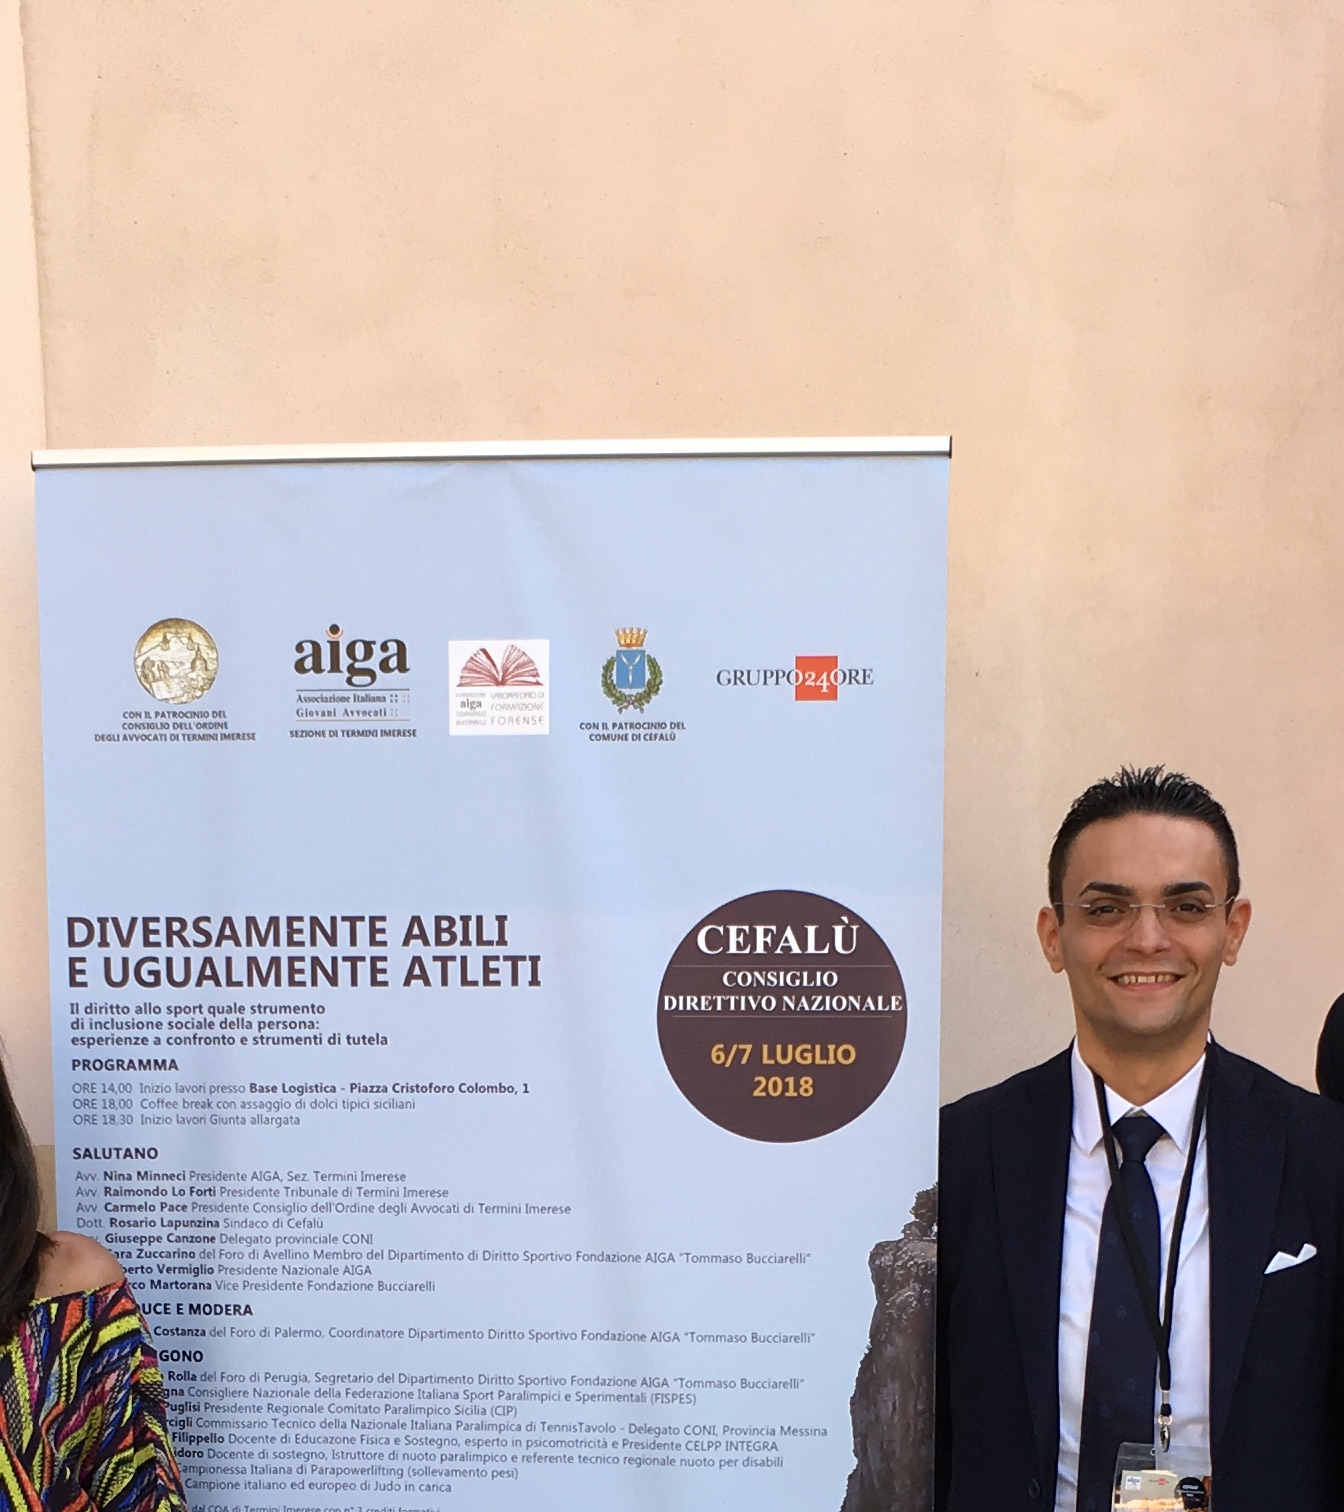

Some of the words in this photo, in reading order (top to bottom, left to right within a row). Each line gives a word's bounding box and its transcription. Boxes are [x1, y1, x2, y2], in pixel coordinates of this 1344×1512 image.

[294, 624, 411, 688] aiga
[459, 698, 482, 711] aiga
[122, 710, 142, 719] CON
[143, 710, 152, 719] IL
[154, 710, 209, 719] PATROCINIO
[211, 710, 227, 719] DEL
[490, 715, 545, 726] FORENSE
[121, 721, 170, 730] CONSIGLIO
[172, 721, 228, 730] DELL'ORDINE
[289, 729, 326, 738] SEZIONE
[328, 729, 338, 738] DI
[340, 728, 378, 737] TERMINI
[379, 728, 417, 737] IMERESE
[579, 722, 599, 730] CON
[601, 722, 609, 730] IL
[611, 721, 667, 730] PATROCINIO
[669, 721, 686, 730] DEL
[94, 733, 120, 742] DEGLI
[121, 733, 167, 742] AVVOCATI
[169, 733, 179, 741] DI
[181, 732, 218, 741] TERMINI
[219, 732, 255, 741] IMERESE
[588, 732, 629, 741] COMUNE
[631, 732, 641, 741] DI
[642, 731, 676, 741] CEFALÙ
[66, 915, 387, 948] DIVERSAMENTE
[401, 914, 508, 947] ABILI
[697, 916, 859, 954] CEFALÙ
[68, 956, 88, 987] E
[103, 955, 389, 988] UGUALMENTE
[402, 954, 541, 987] ATLETI
[722, 970, 838, 987] CONSIGLIO
[69, 1002, 79, 1014] Il
[84, 1002, 130, 1015] diritto
[134, 1002, 161, 1015] allo
[166, 1003, 203, 1018] sport
[207, 1002, 245, 1017] quale
[250, 1003, 325, 1014] strumento
[664, 995, 776, 1011] DIRETTIVO
[782, 995, 902, 1011] NAZIONALE
[70, 1017, 84, 1030] di
[89, 1017, 163, 1030] inclusione
[167, 1017, 215, 1030] sociale
[218, 1016, 252, 1030] della
[257, 1020, 319, 1033] persona:
[70, 1032, 149, 1049] esperienze
[153, 1036, 161, 1045] a
[166, 1032, 235, 1045] confronto
[239, 1036, 248, 1045] e
[252, 1032, 322, 1045] strumenti
[327, 1032, 341, 1045] di
[345, 1032, 387, 1045] tutela
[710, 1043, 752, 1067] 6/7
[762, 1044, 856, 1064] LUGLIO
[71, 1058, 178, 1071] PROGRAMMA
[72, 1082, 96, 1093] ORE
[101, 1082, 132, 1095] 14,00
[139, 1082, 171, 1093] Inizio
[175, 1082, 205, 1093] lavori
[209, 1085, 245, 1095] presso
[249, 1082, 278, 1093] Base
[281, 1082, 336, 1096] Logistica
[349, 1082, 388, 1093] Piazza
[391, 1081, 455, 1093] Cristoforo
[458, 1082, 518, 1095] Colombo,
[522, 1082, 529, 1093] 1
[752, 1076, 813, 1096] 2018
[72, 1098, 97, 1109] ORE
[139, 1097, 179, 1109] Coffee
[182, 1097, 213, 1109] break
[215, 1100, 236, 1109] con
[239, 1097, 291, 1112] assaggio
[294, 1098, 306, 1109] di
[309, 1097, 338, 1109] dolci
[341, 1098, 370, 1112] tipici
[372, 1097, 415, 1109] siciliani
[72, 1113, 98, 1125] ORE
[140, 1113, 173, 1125] Inizio
[175, 1113, 206, 1125] lavori
[209, 1113, 246, 1125] Giunta
[249, 1113, 300, 1128] allargata
[72, 1146, 158, 1160] SALUTANO
[103, 1170, 132, 1181] Nina
[136, 1169, 186, 1181] Minneci
[189, 1170, 247, 1181] Presidente
[250, 1170, 283, 1183] AIGA,
[313, 1170, 357, 1181] Termini
[360, 1170, 406, 1182] Imerese
[109, 1216, 157, 1228] Rosario
[160, 1216, 220, 1231] Lapunzina
[223, 1217, 269, 1228] Sindaco
[272, 1217, 283, 1228] di
[286, 1217, 323, 1229] Cefalù
[104, 1232, 163, 1246] Giuseppe
[166, 1232, 216, 1243] Canzone
[219, 1232, 271, 1247] Delegato
[275, 1233, 338, 1247] provinciale
[342, 1233, 373, 1244] CONI
[176, 1302, 183, 1315] E
[188, 1303, 253, 1316] MODERA
[184, 1477, 240, 1492] Campione
[244, 1478, 287, 1490] italiano
[290, 1479, 305, 1490] ed
[308, 1481, 356, 1493] europeo
[359, 1479, 370, 1490] di
[373, 1480, 401, 1491] Judo
[404, 1480, 415, 1491] in
[418, 1483, 451, 1492] carica
